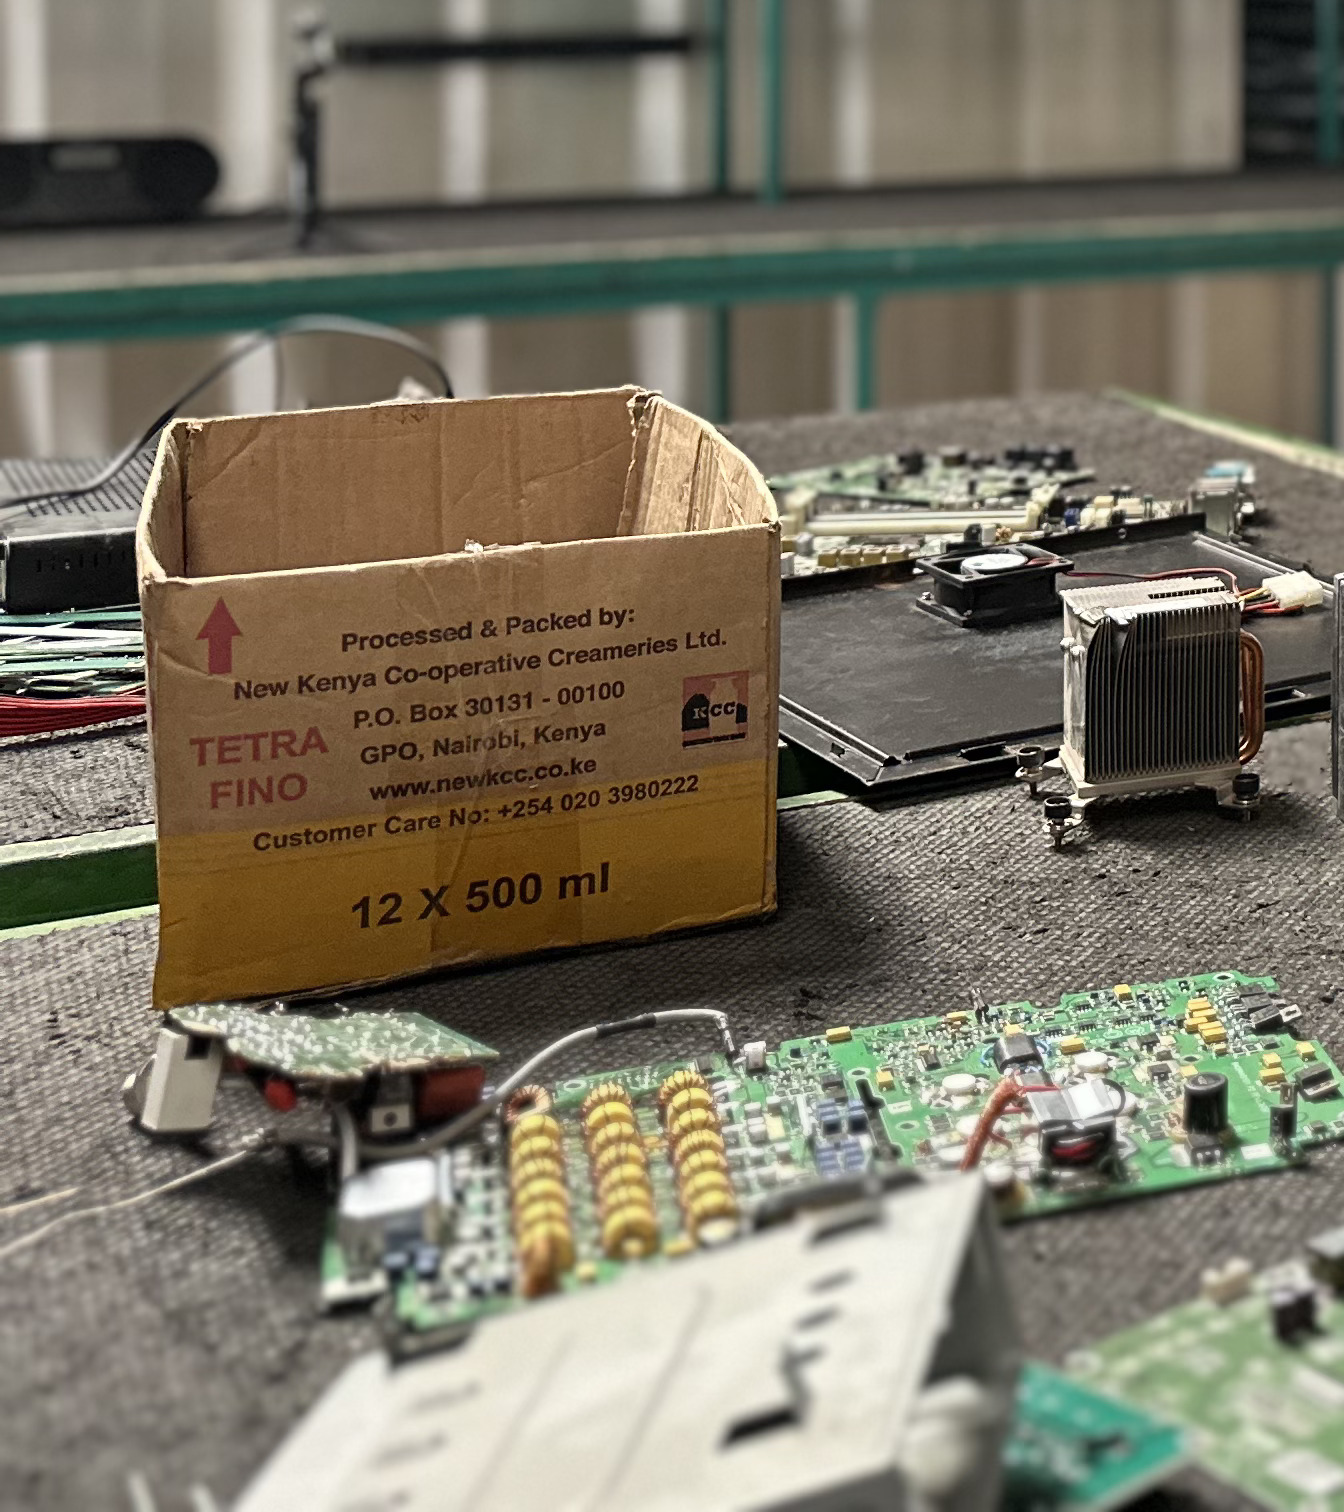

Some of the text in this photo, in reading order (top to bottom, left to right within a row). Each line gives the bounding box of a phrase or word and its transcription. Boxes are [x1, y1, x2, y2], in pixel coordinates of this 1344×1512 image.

[341, 607, 635, 652] Processed & Packed by:
[234, 629, 727, 700] New Kenya Co-operative Creameries Ltd.
[353, 707, 400, 729] P.O.
[410, 704, 457, 723] Box
[465, 691, 532, 717] 30131
[558, 681, 625, 706] 00100
[692, 701, 735, 719] KCC
[189, 726, 329, 767] TETRA
[360, 721, 606, 765] GPO, Nairobi, Kenya
[210, 772, 308, 809] FINO
[369, 757, 597, 801] www.newkcc.co.ke
[254, 775, 698, 851] Customer Care No: +254 020 3980222
[351, 861, 609, 929] 12 X 500 ml
